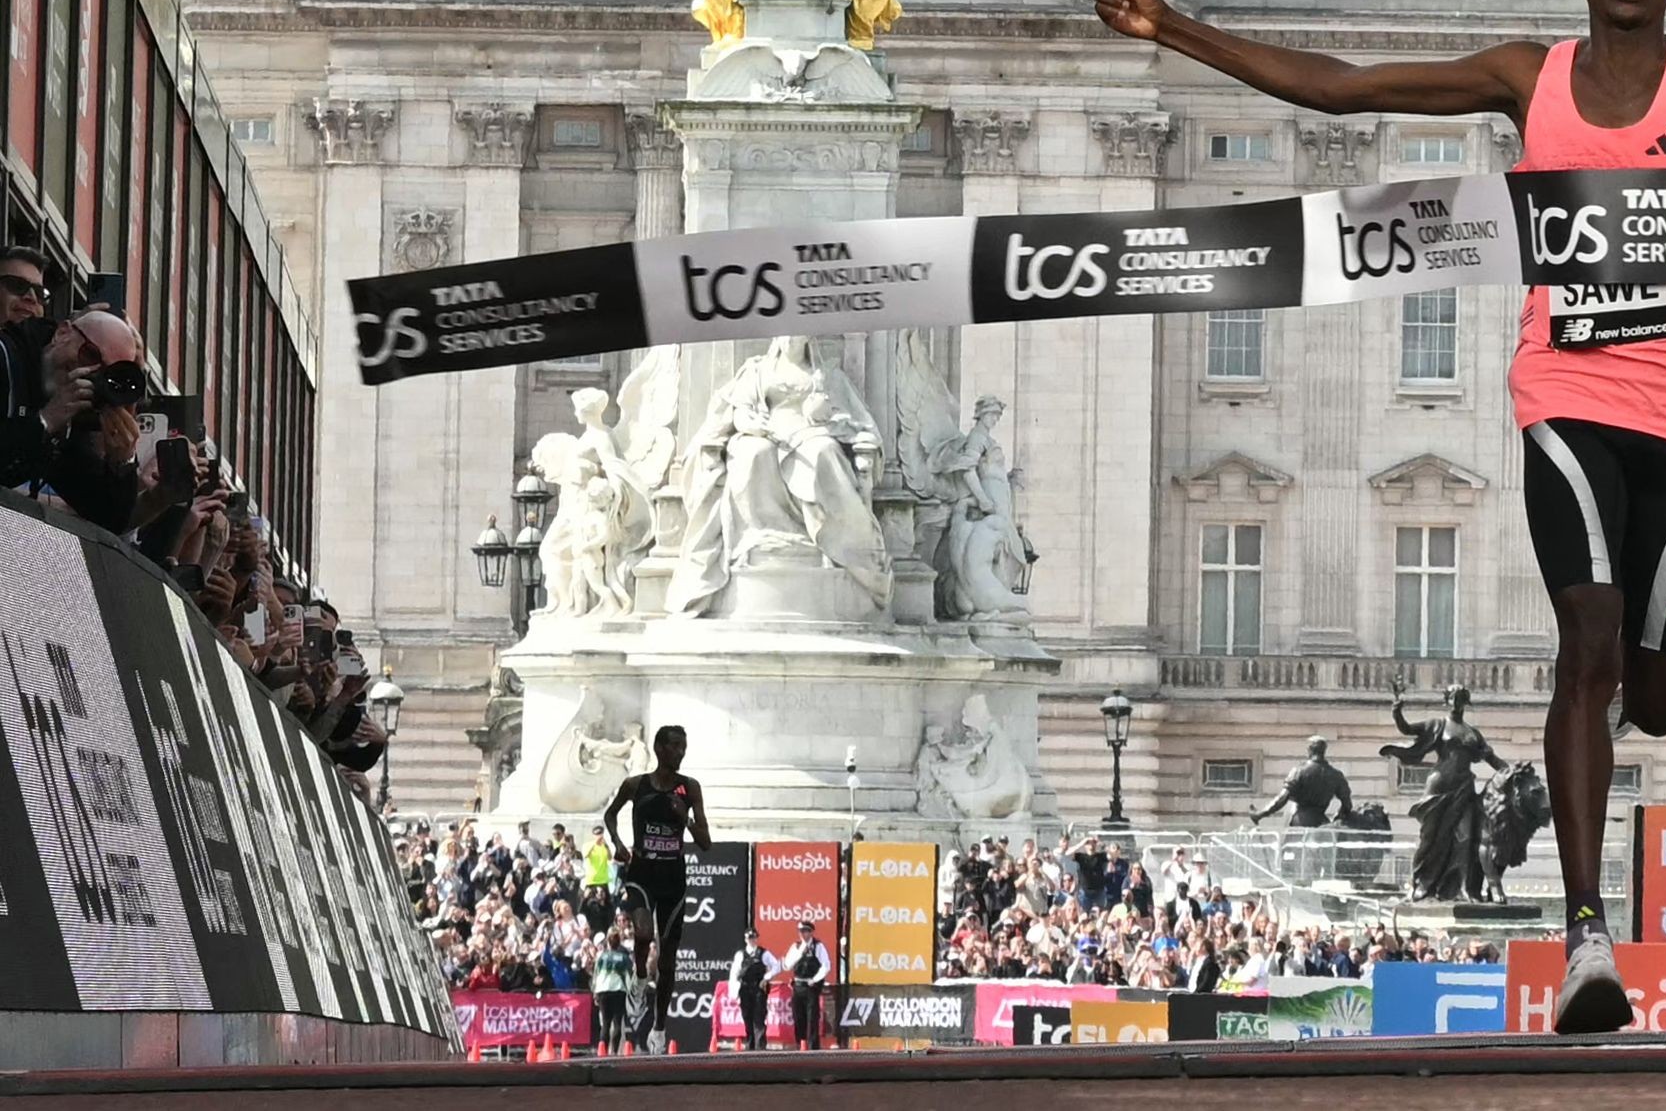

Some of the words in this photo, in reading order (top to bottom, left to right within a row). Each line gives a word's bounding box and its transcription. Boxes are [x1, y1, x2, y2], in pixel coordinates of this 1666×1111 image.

[1409, 199, 1449, 219] TATA
[1123, 227, 1189, 246] TATA
[1417, 220, 1500, 244] CONSULTANCY
[1528, 193, 1609, 266] tcs
[793, 242, 852, 263] TATA
[1336, 212, 1416, 280] tcs
[1004, 232, 1110, 301] tcs
[1118, 246, 1271, 271] CONSULTANCY
[1424, 247, 1481, 270] SERVICES
[794, 262, 932, 289] CONSULTANCY
[1115, 274, 1215, 296] SERVICES
[430, 281, 503, 307] TATA
[681, 254, 784, 322] tcs
[435, 292, 599, 328] CONSULTANCY
[797, 291, 885, 315] SERVICES
[438, 323, 546, 354] SERVICES
[1595, 328, 1620, 340] new
[685, 865, 738, 876] SULTANCY
[760, 852, 832, 873] HubSpot
[856, 858, 929, 879] FLORA
[685, 876, 713, 887] VICES
[683, 896, 716, 923] cs
[759, 902, 832, 923] HubSpot
[855, 906, 928, 925] FLORA
[854, 952, 926, 972] FLORA
[508, 1005, 573, 1019] LONDON
[904, 997, 961, 1013] LONDON
[483, 1019, 573, 1033] MARATHON
[879, 1011, 961, 1028] MARATHON
